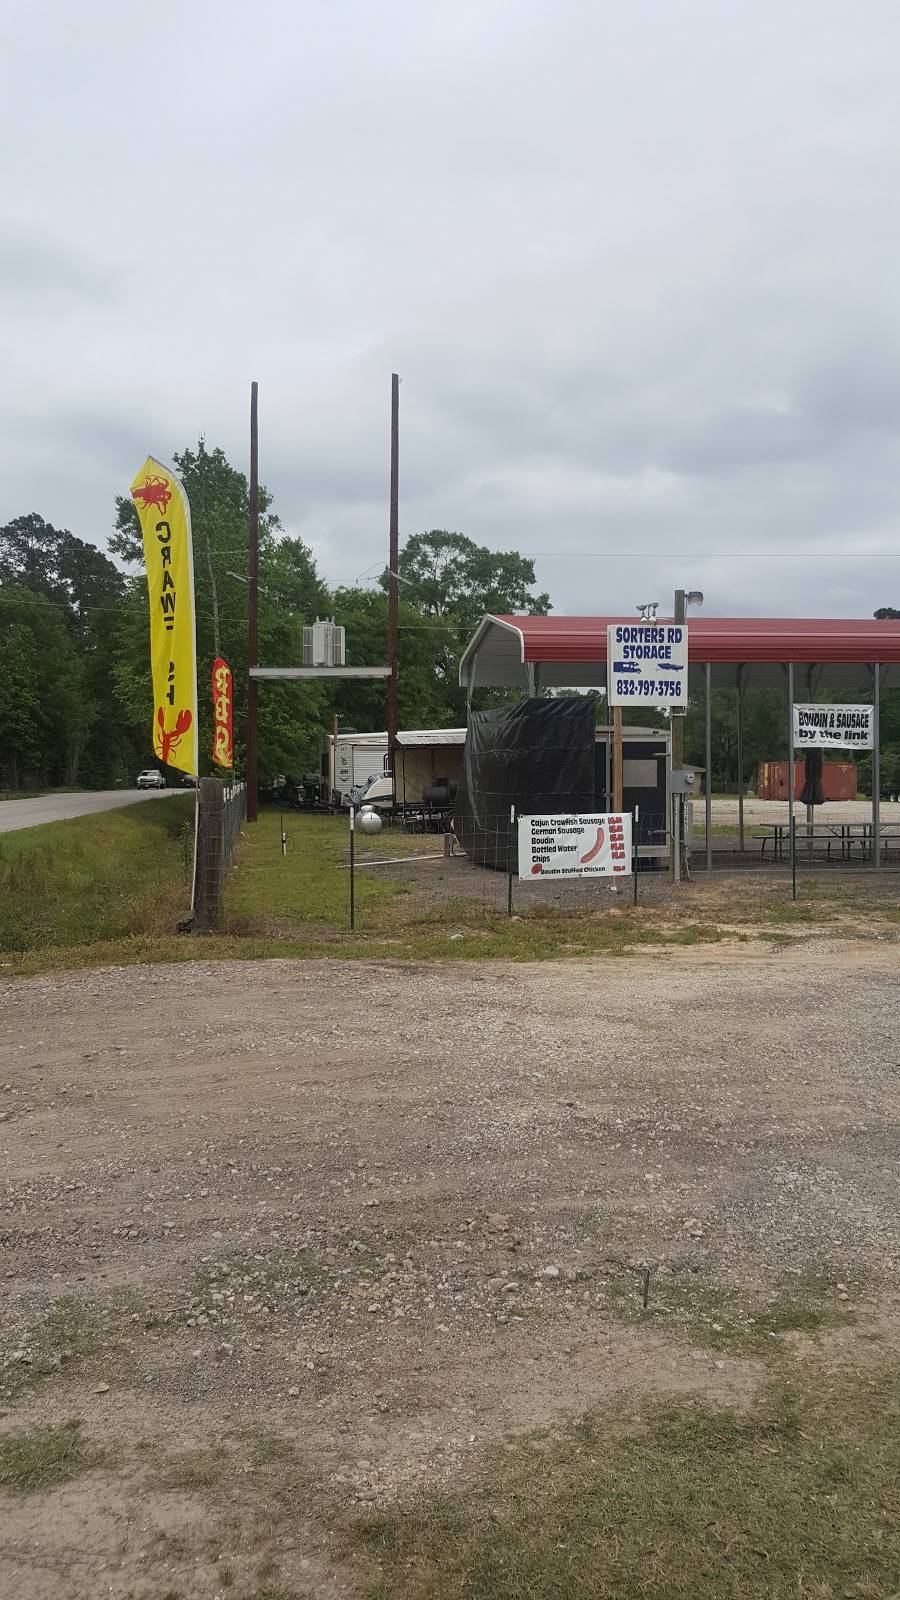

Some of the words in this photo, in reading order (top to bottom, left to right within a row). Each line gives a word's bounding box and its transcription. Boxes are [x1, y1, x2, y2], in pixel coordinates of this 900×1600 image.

[616, 627, 665, 643] SORTERS
[667, 628, 683, 643] RD
[623, 645, 672, 659] STORAGE
[616, 679, 682, 696] 832-797-3756
[798, 711, 828, 728] BOUDIN
[829, 713, 835, 728] &
[836, 713, 869, 728] SAUSAGE
[799, 729, 816, 739] by
[819, 730, 841, 739] the
[844, 730, 868, 740] link
[530, 819, 549, 827] Cajun
[550, 818, 578, 826] Crawfish
[579, 817, 605, 825] Sausage
[531, 837, 555, 845] Boudin
[532, 855, 550, 863] Chips
